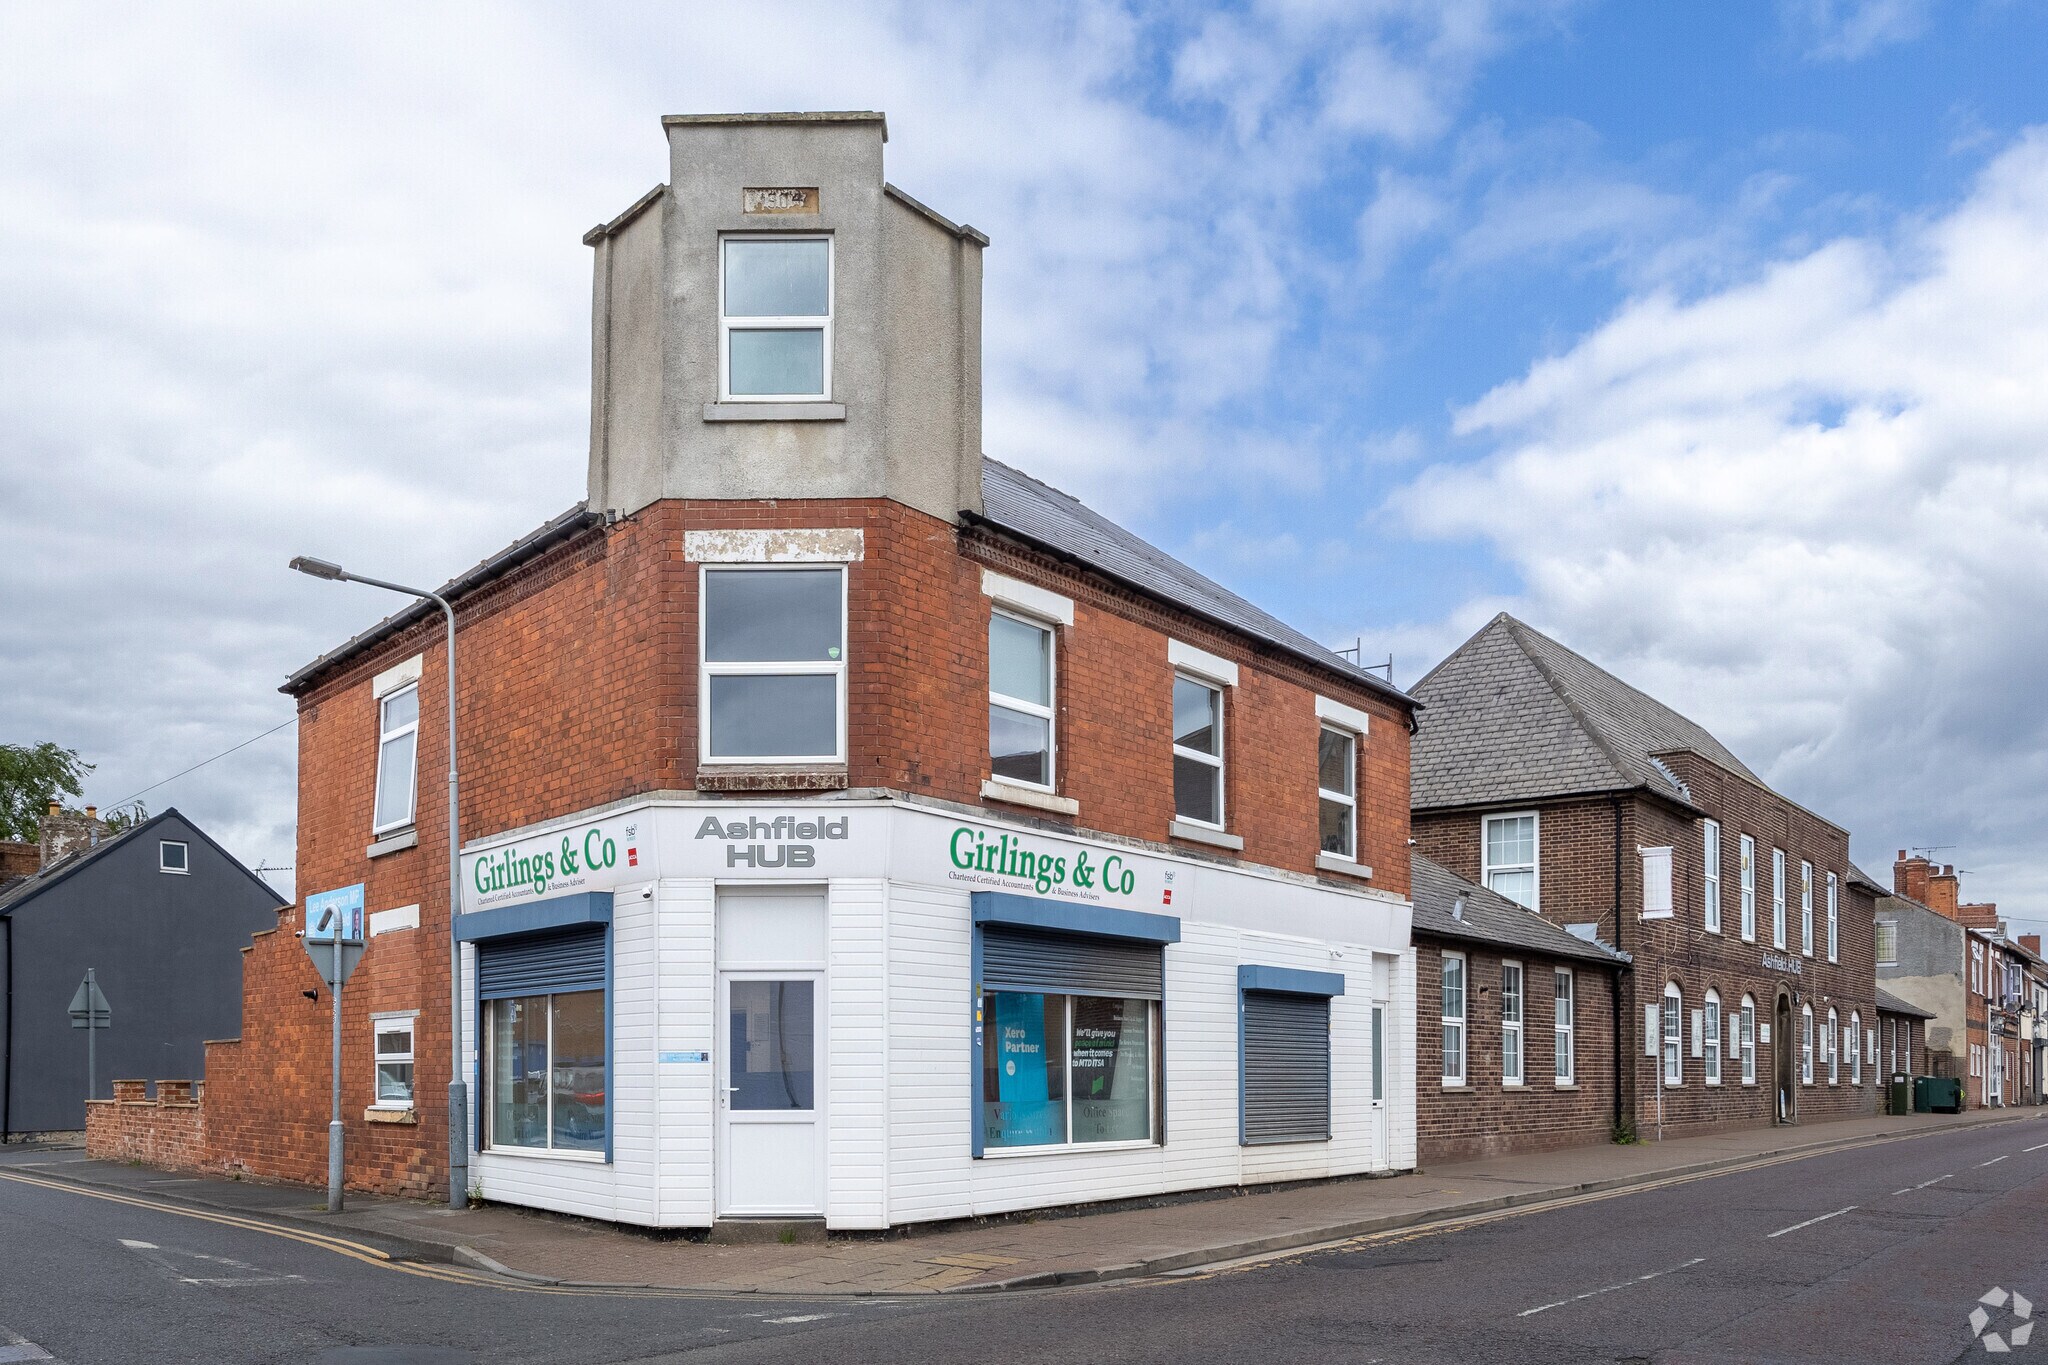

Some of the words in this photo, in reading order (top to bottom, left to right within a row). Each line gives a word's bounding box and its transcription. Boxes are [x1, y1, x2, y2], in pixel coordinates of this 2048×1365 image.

[695, 816, 848, 840] Ashfield
[474, 848, 555, 895] Girlings
[560, 836, 580, 876] &
[584, 828, 616, 871] Co
[727, 844, 815, 868] HUB
[950, 827, 1066, 895] Girlings
[1072, 851, 1095, 889] &
[1102, 855, 1135, 895] Co
[948, 871, 976, 883] Chartered
[977, 875, 1001, 886] Certified
[1001, 879, 1034, 891] Accountants
[1058, 888, 1079, 898] Business
[1080, 891, 1100, 901] Advisers
[1005, 1027, 1026, 1039] Xero
[1091, 1028, 1104, 1039] give
[1103, 1030, 1116, 1039] you
[1005, 1041, 1040, 1053] Partner
[1073, 1049, 1089, 1057] when
[1095, 1050, 1114, 1058] comes
[1072, 1059, 1079, 1067] to
